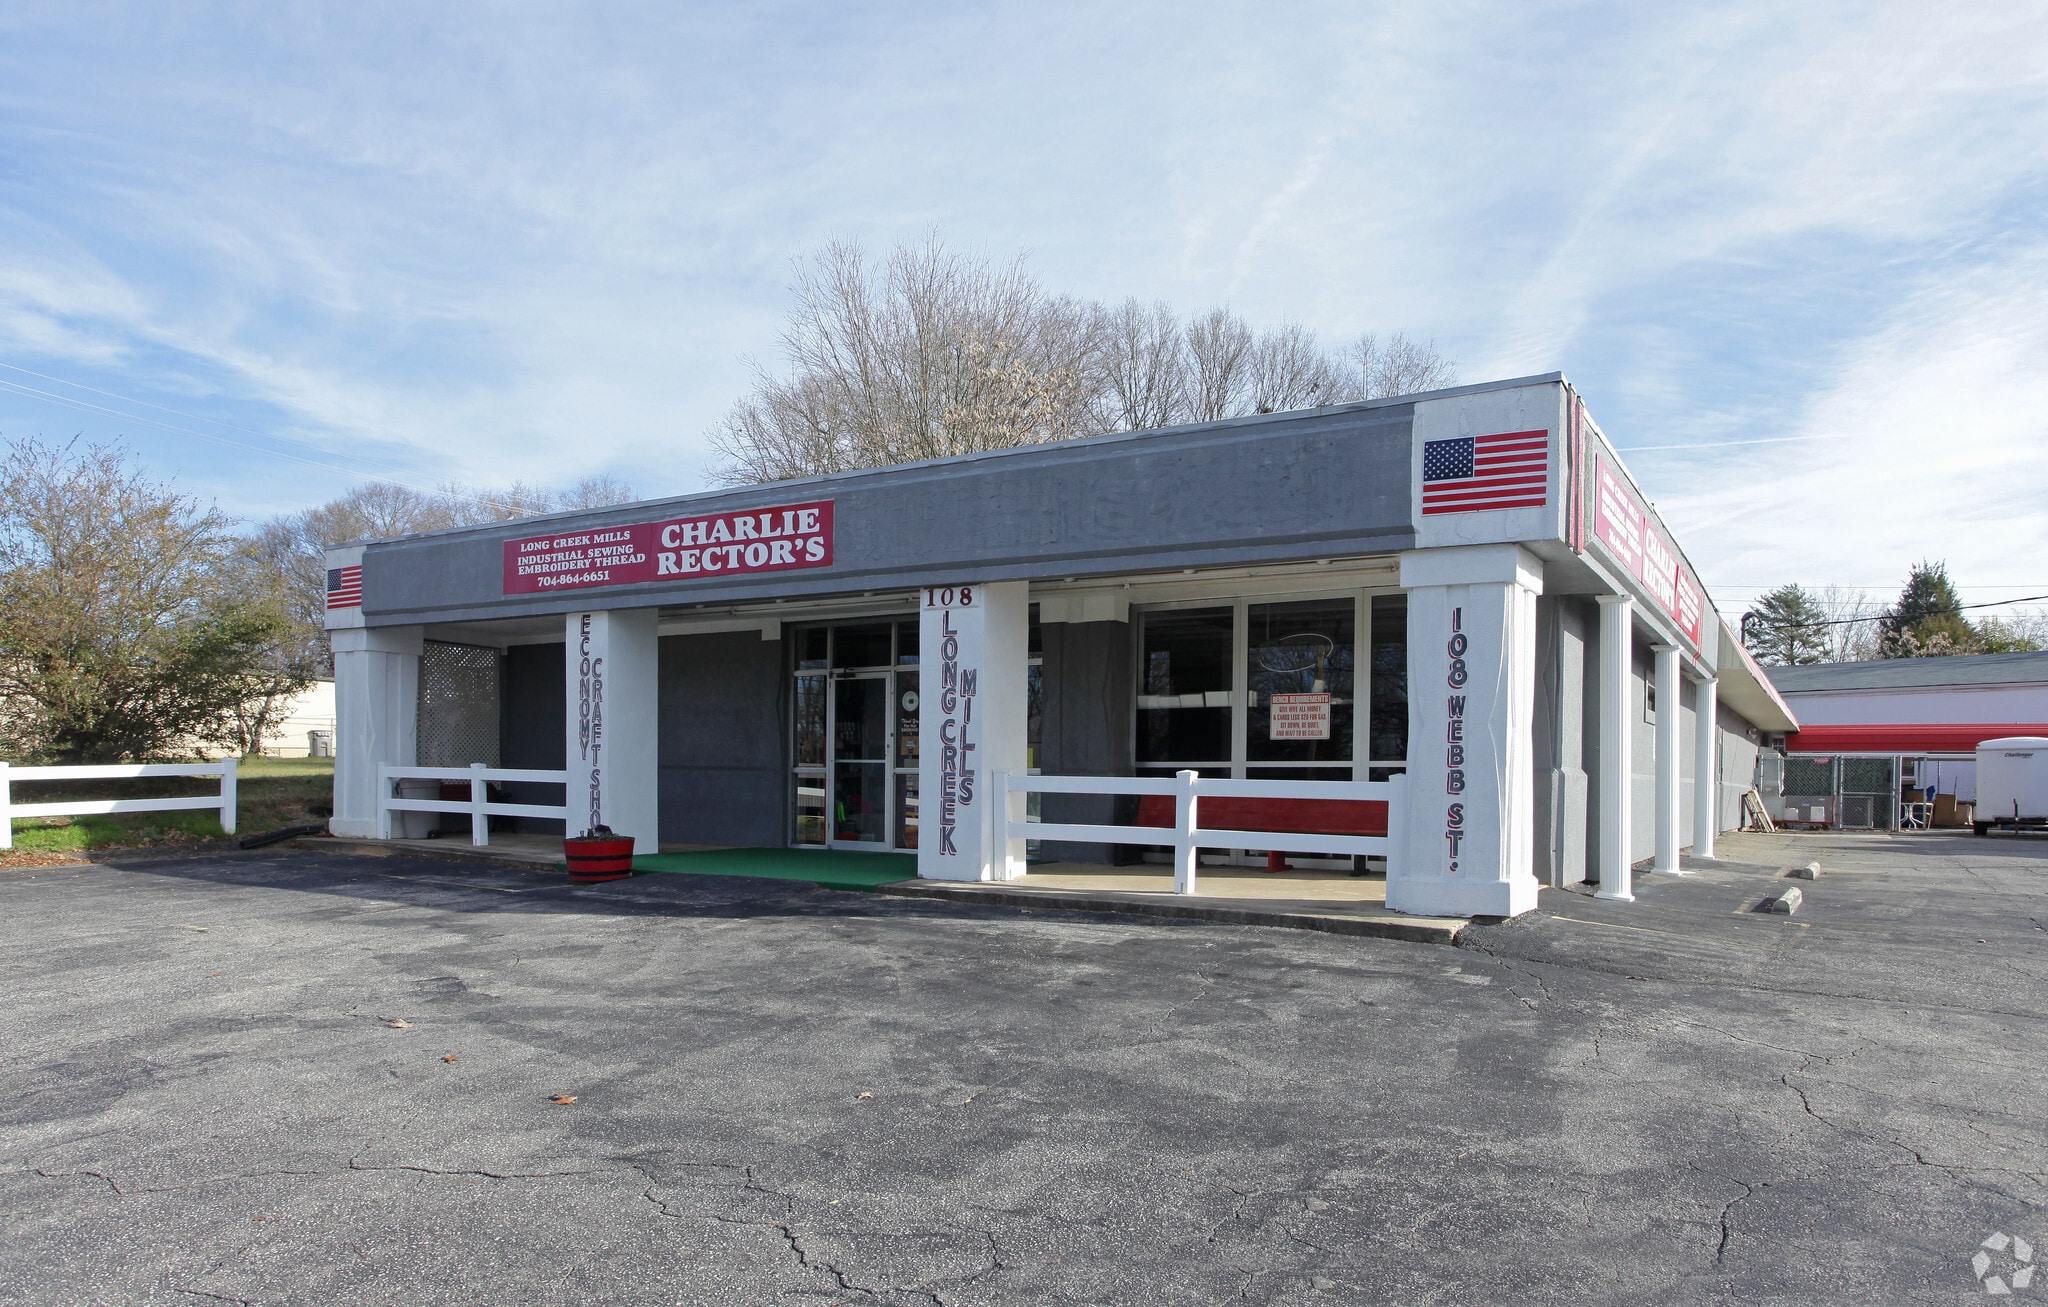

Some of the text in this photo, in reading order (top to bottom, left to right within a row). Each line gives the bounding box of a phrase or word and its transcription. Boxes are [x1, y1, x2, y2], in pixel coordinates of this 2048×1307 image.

[520, 530, 631, 552] LONG CREEK MILLS
[661, 508, 820, 548] CHARLIE
[517, 544, 634, 566] INDUSTRIAL SEWING
[518, 553, 646, 575] EMBROIDERY THREAD
[657, 536, 825, 575] RECTOR'S
[537, 570, 610, 587] 704-864-6651
[926, 587, 973, 607] 108
[579, 614, 592, 761] ECONOMY
[589, 657, 603, 830] CRAFT SHO
[939, 610, 958, 856] LONG CREEK
[958, 668, 977, 806] MILLS
[1446, 695, 1467, 795] WEBB
[1445, 802, 1464, 872] ST.
